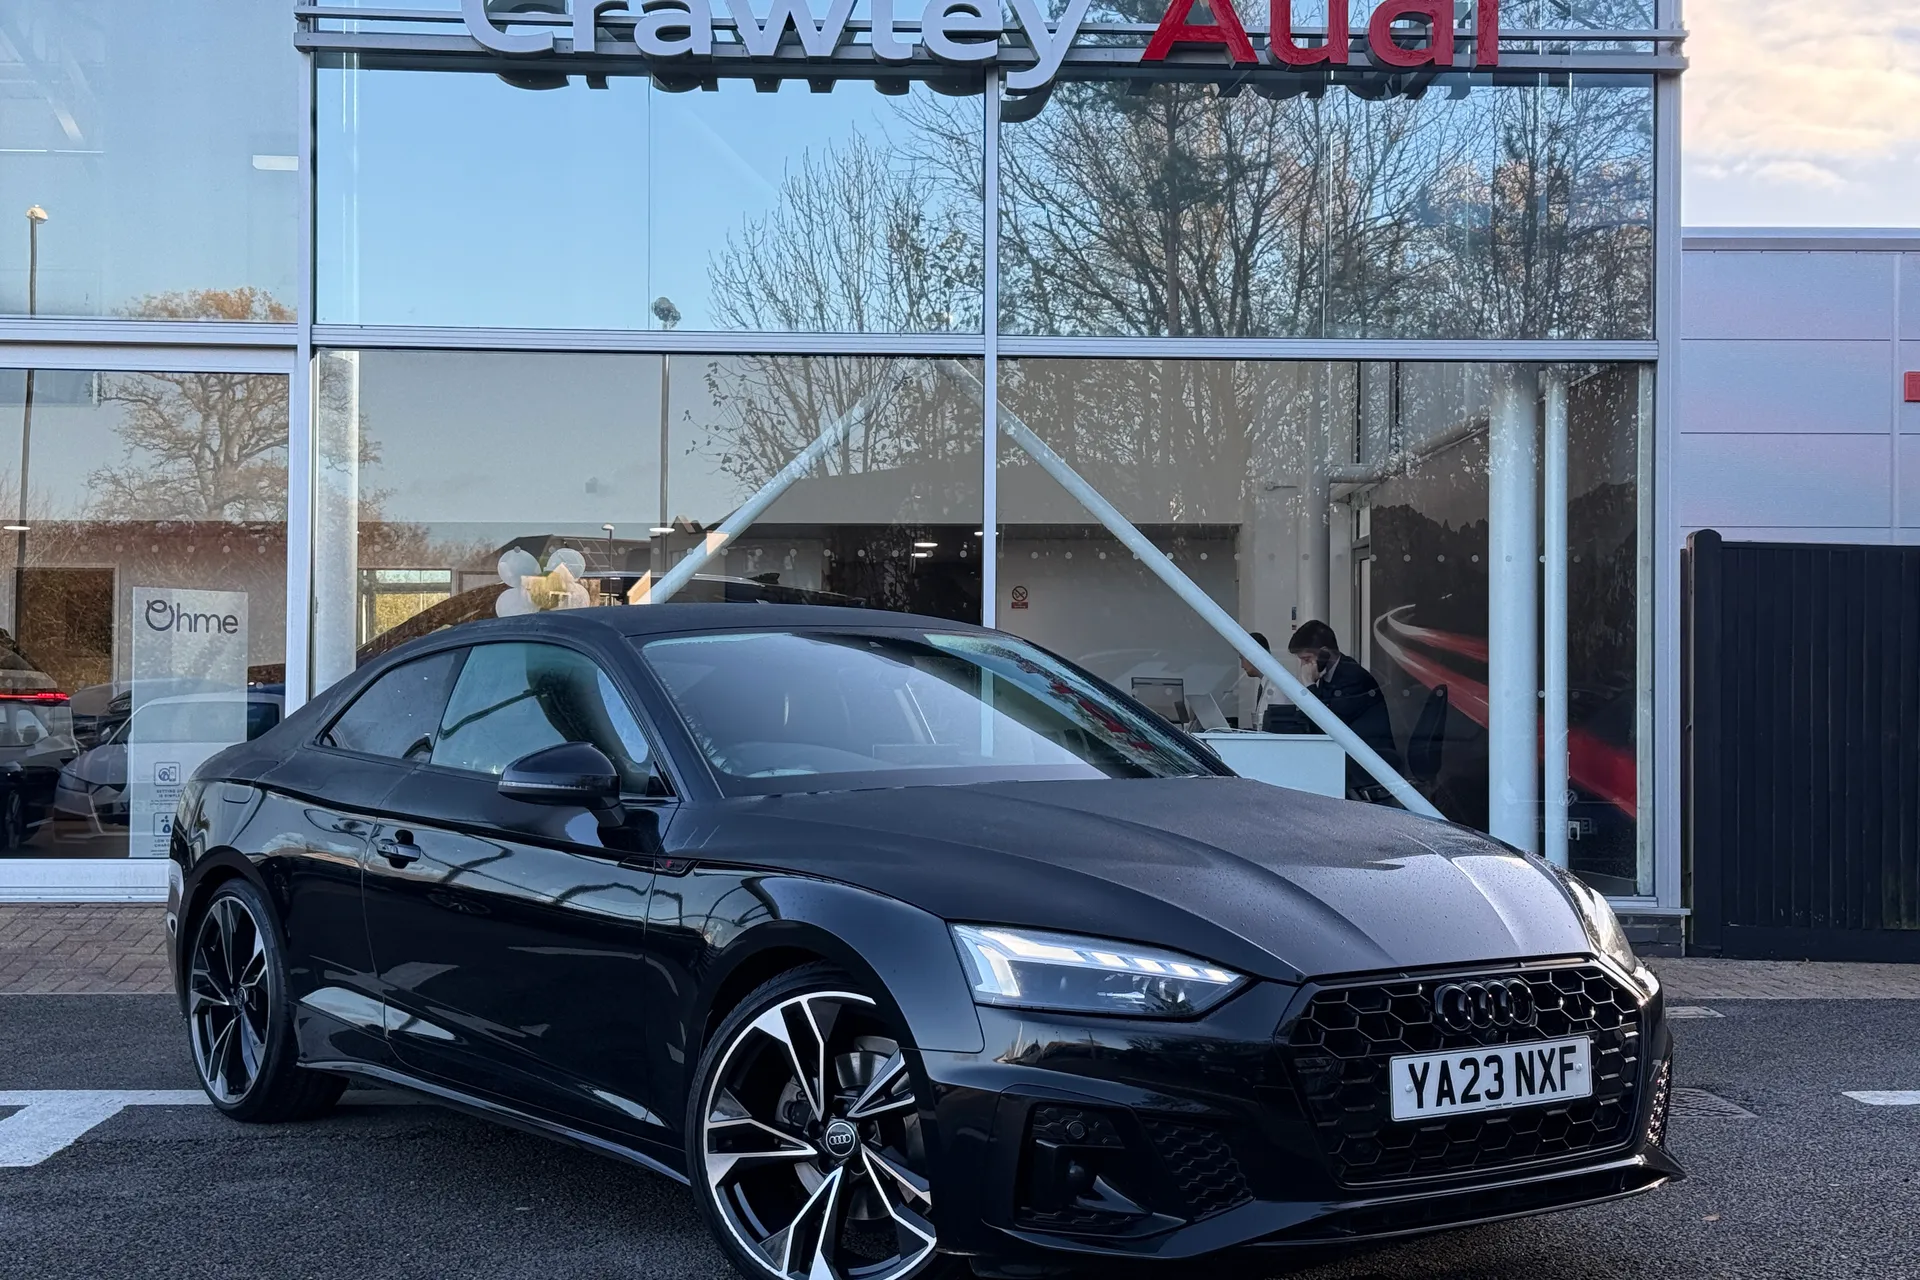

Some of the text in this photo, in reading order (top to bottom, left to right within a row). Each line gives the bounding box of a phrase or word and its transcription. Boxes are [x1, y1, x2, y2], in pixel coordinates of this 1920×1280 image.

[462, 0, 1498, 93] Crawley Audi
[145, 599, 239, 634] Ohme
[1408, 1045, 1577, 1109] YA23 NXF
